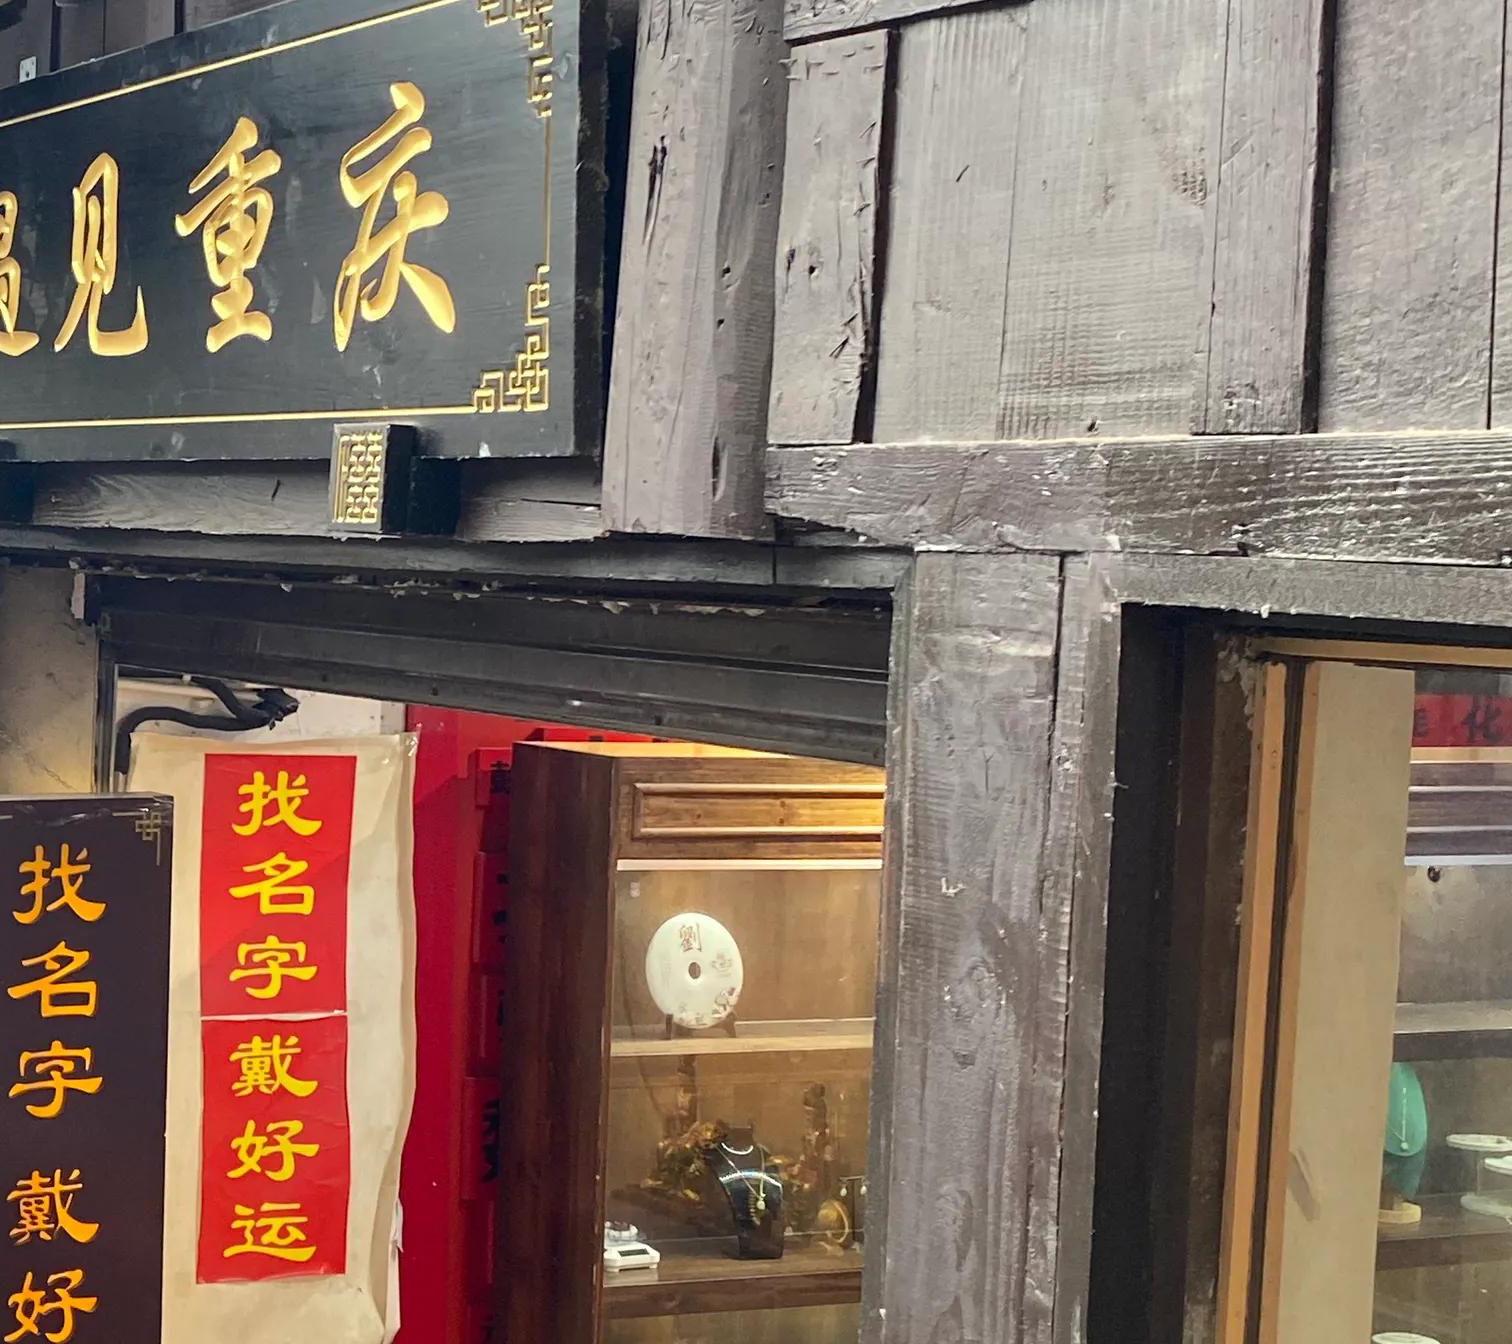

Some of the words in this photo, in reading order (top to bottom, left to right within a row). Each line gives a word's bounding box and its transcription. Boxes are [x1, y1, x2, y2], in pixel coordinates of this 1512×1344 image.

[7, 843, 107, 1118] 找名字
[228, 771, 322, 998] 找名字
[226, 1035, 319, 1262] 戴好运
